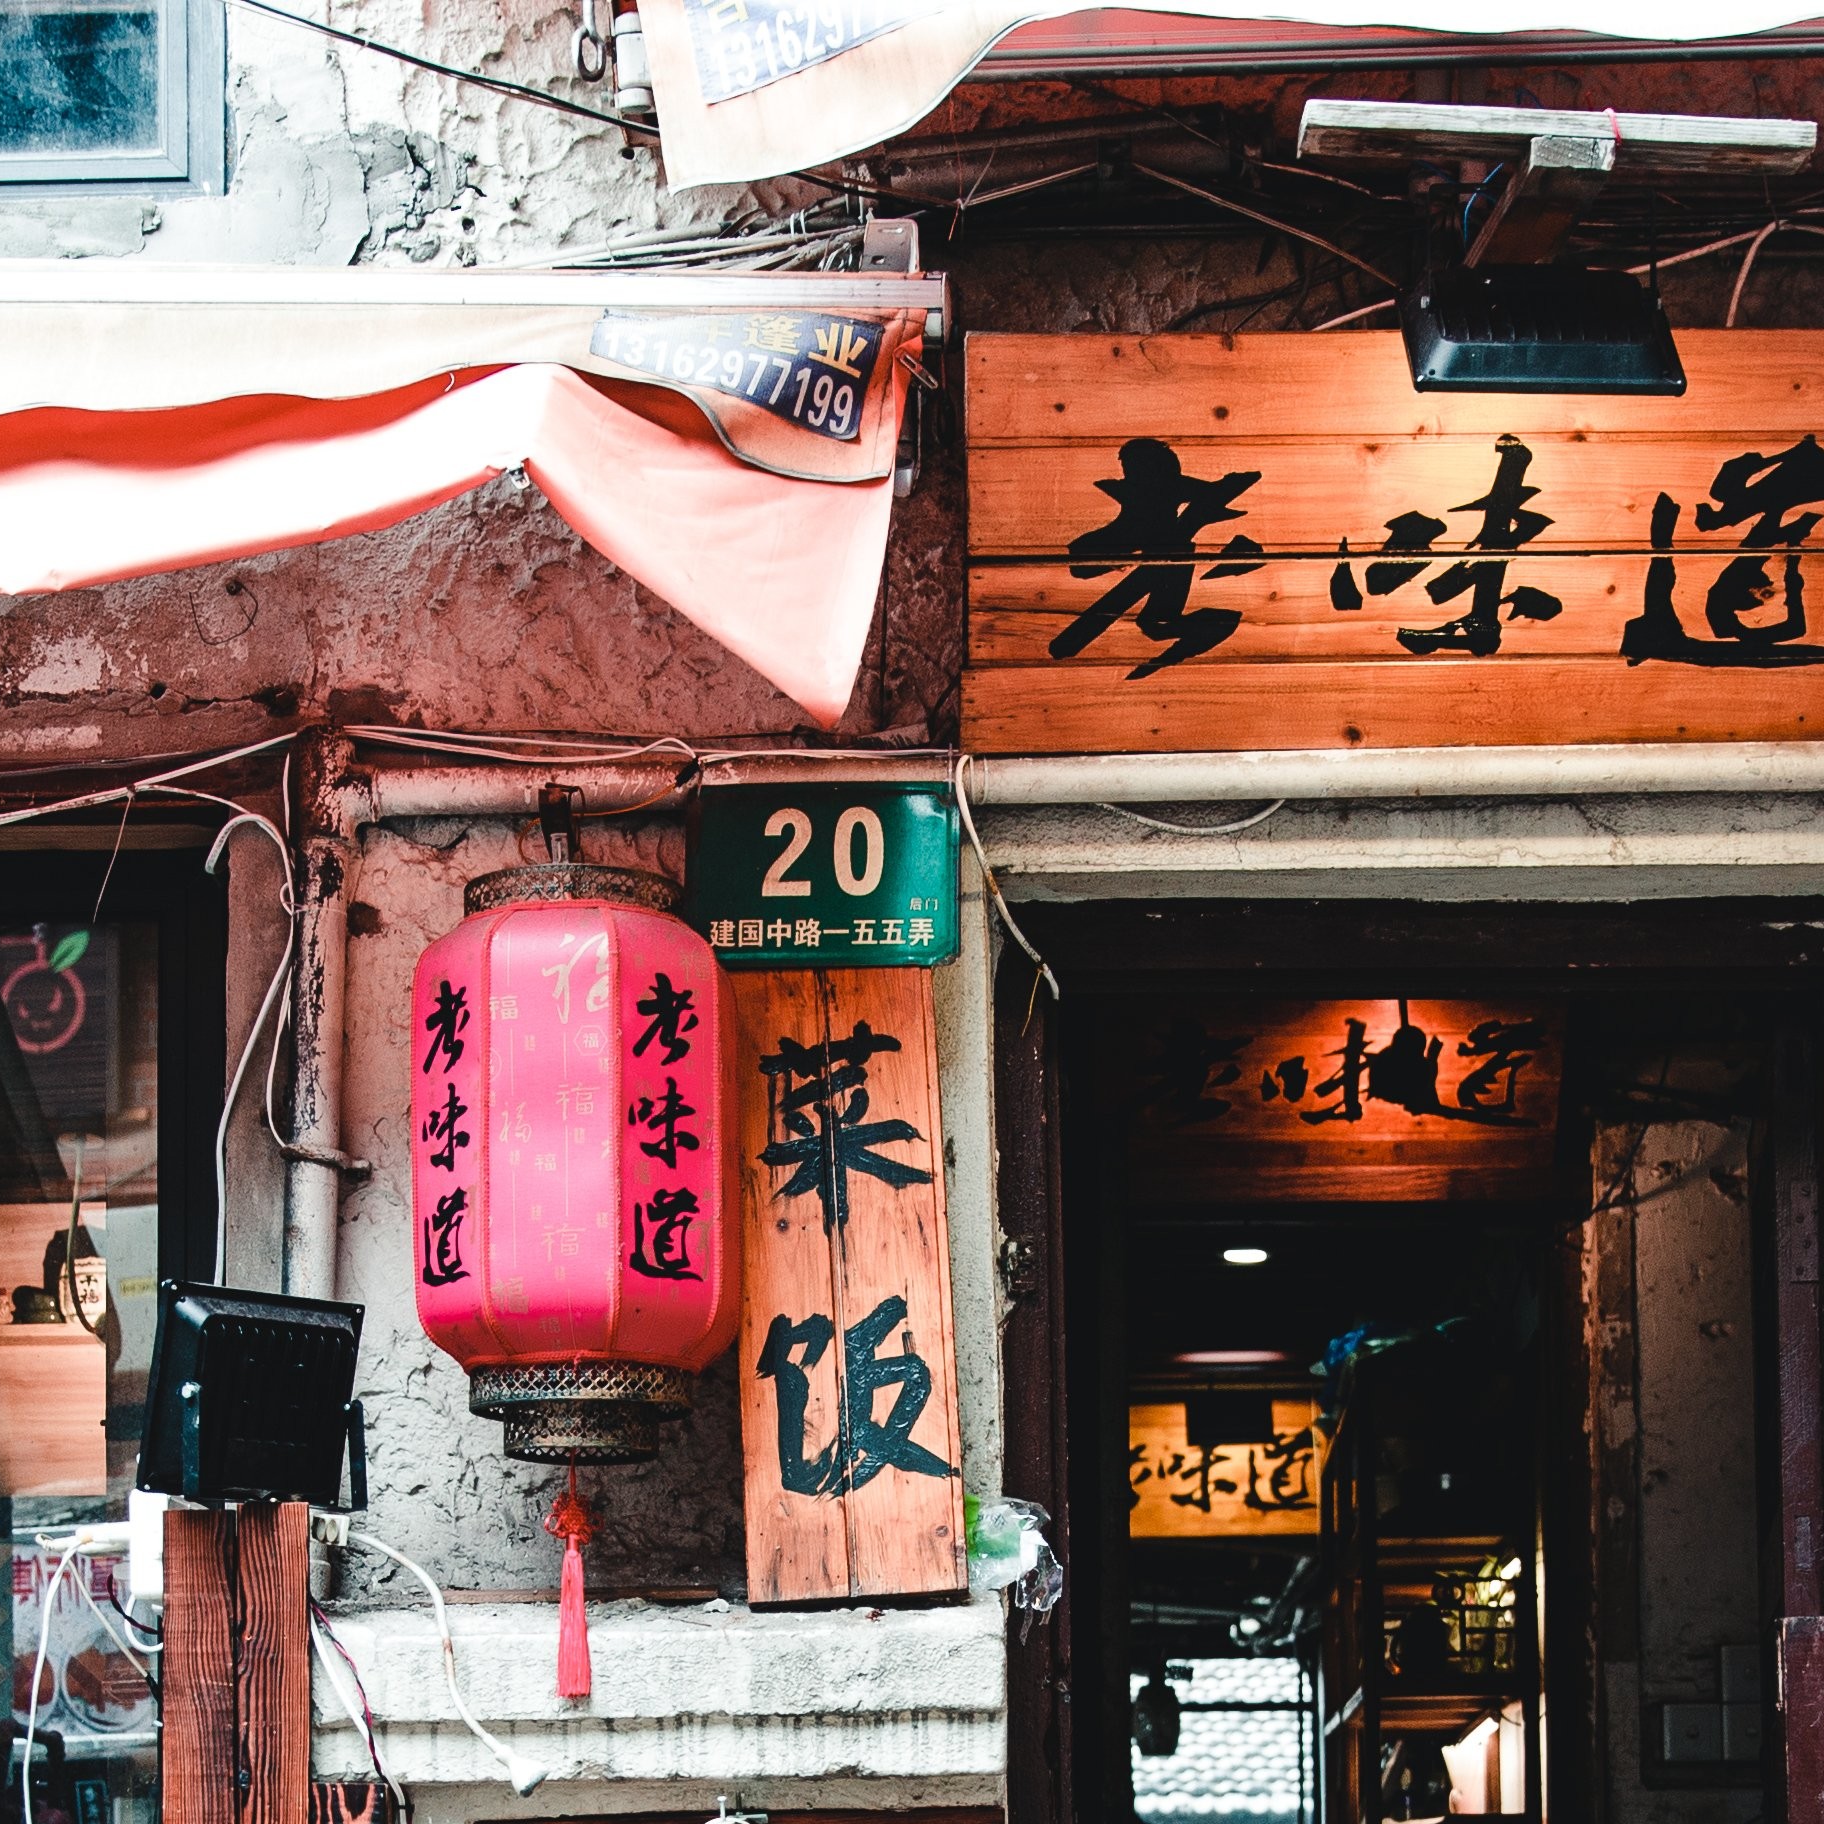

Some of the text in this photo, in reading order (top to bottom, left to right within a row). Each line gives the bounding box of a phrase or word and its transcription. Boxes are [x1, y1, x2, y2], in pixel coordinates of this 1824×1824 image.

[604, 331, 854, 434] 13162977199
[761, 806, 885, 897] 20
[709, 918, 935, 948] 建国中路一五五弄
[909, 897, 939, 912] 后门
[756, 1019, 961, 1504] 菜饭
